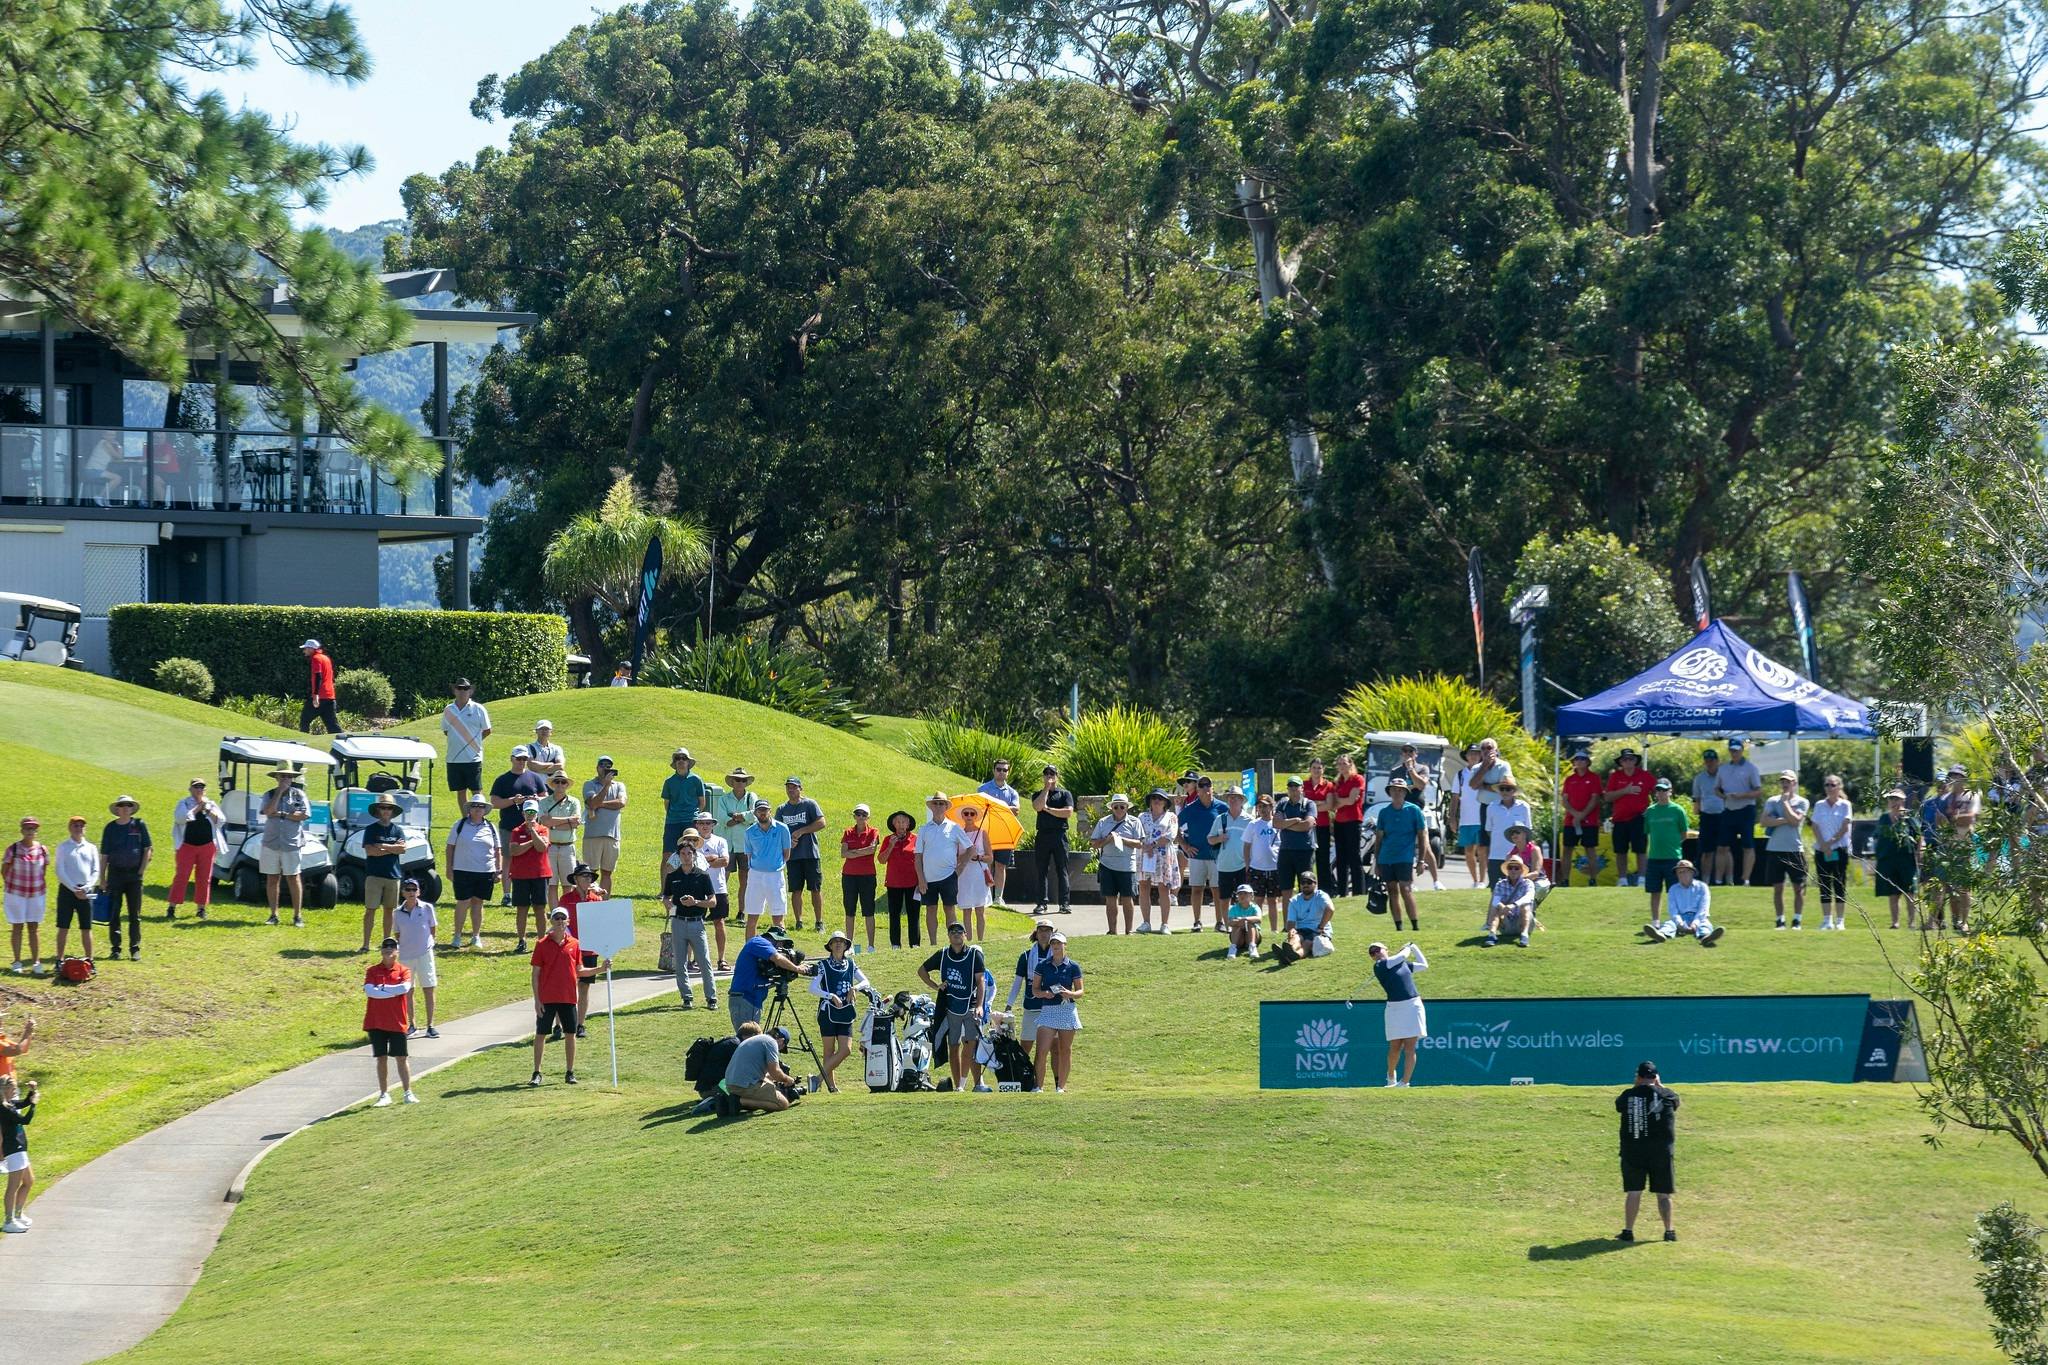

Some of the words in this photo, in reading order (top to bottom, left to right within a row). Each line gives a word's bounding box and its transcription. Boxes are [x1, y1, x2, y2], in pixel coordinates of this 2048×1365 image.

[1649, 708, 1725, 719] COFFSCOAST
[1456, 1034, 1502, 1049] new
[1506, 1030, 1563, 1049] south
[1566, 1029, 1625, 1048] wales
[1678, 1032, 1844, 1055] visitnsw.com
[1295, 1052, 1349, 1071] NSW
[1296, 1071, 1349, 1079] GOVERNMENT
